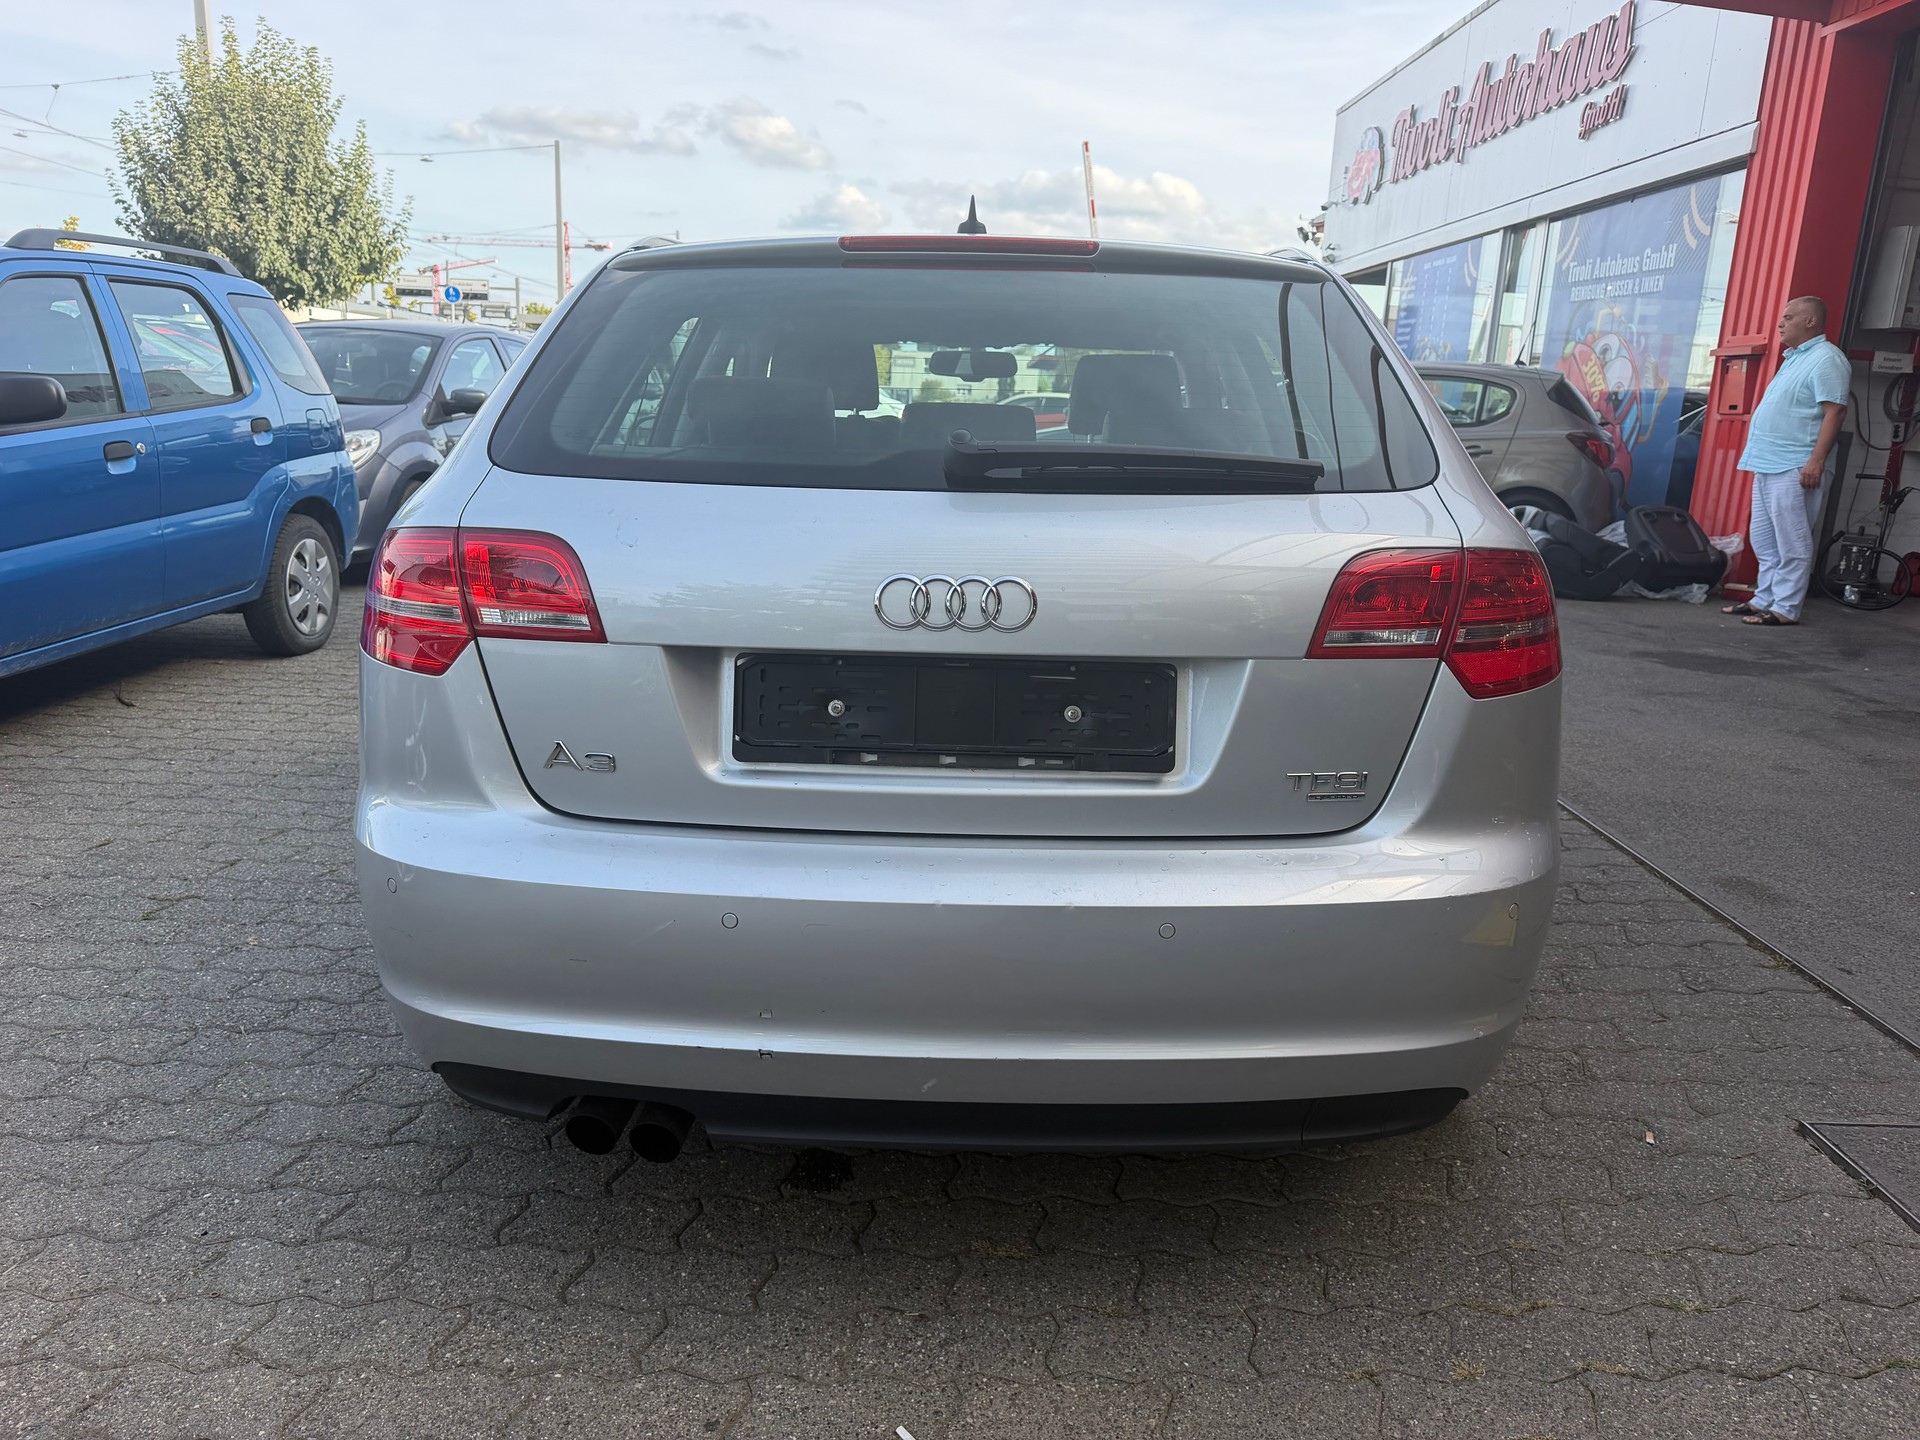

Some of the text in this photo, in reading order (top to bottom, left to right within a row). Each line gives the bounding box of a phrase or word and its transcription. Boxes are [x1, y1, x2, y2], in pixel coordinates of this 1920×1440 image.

[1390, 0, 1634, 183] Tivoli Autohaus
[1578, 84, 1627, 140] GmbH
[1568, 243, 1677, 282] Tivoli Autohaus GmbH
[1634, 278, 1640, 294] &
[1641, 274, 1664, 292] INNEN
[543, 740, 617, 773] A3
[1286, 771, 1368, 791] TFSI
